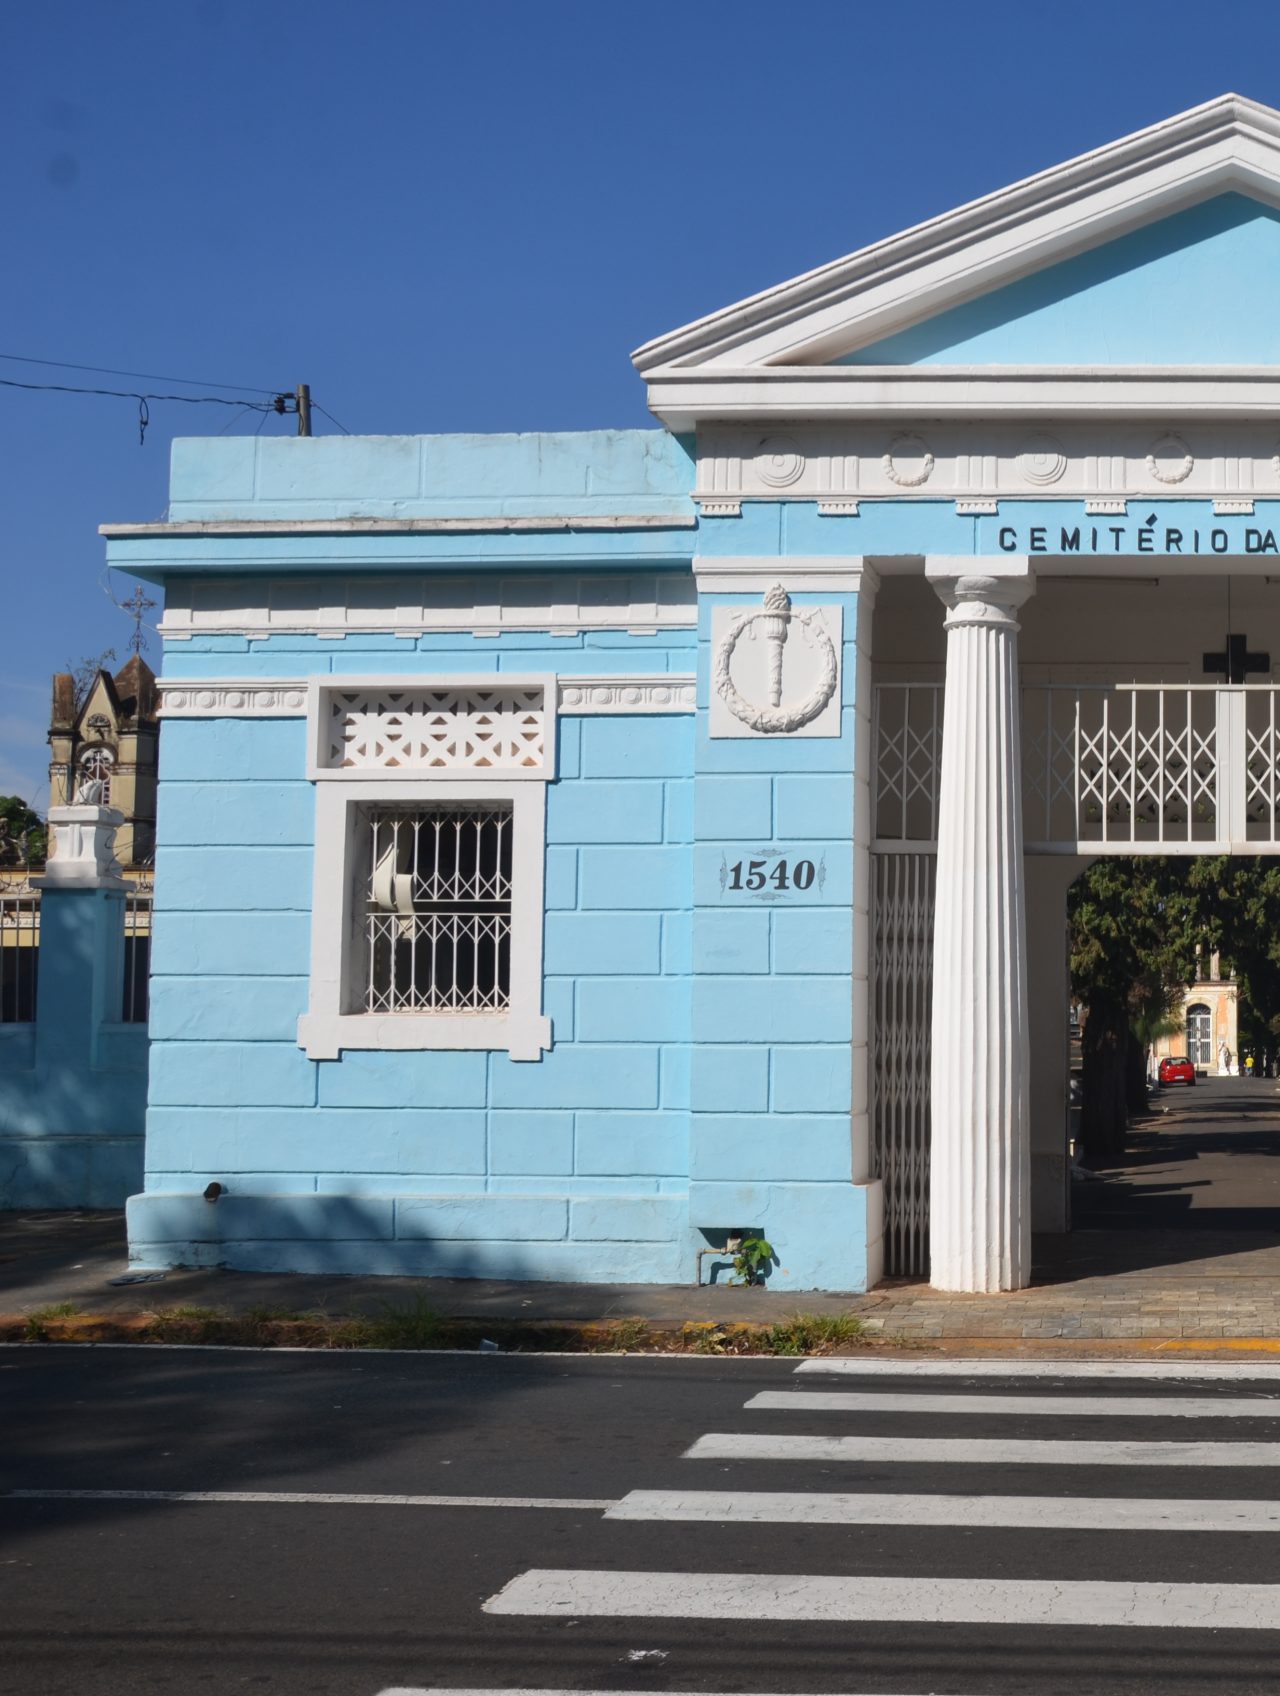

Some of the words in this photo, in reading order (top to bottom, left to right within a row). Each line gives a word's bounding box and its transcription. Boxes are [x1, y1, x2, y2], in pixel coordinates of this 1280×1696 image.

[999, 513, 1229, 553] CEMITÉRIO
[1245, 529, 1279, 553] DA
[728, 859, 815, 890] 1540
